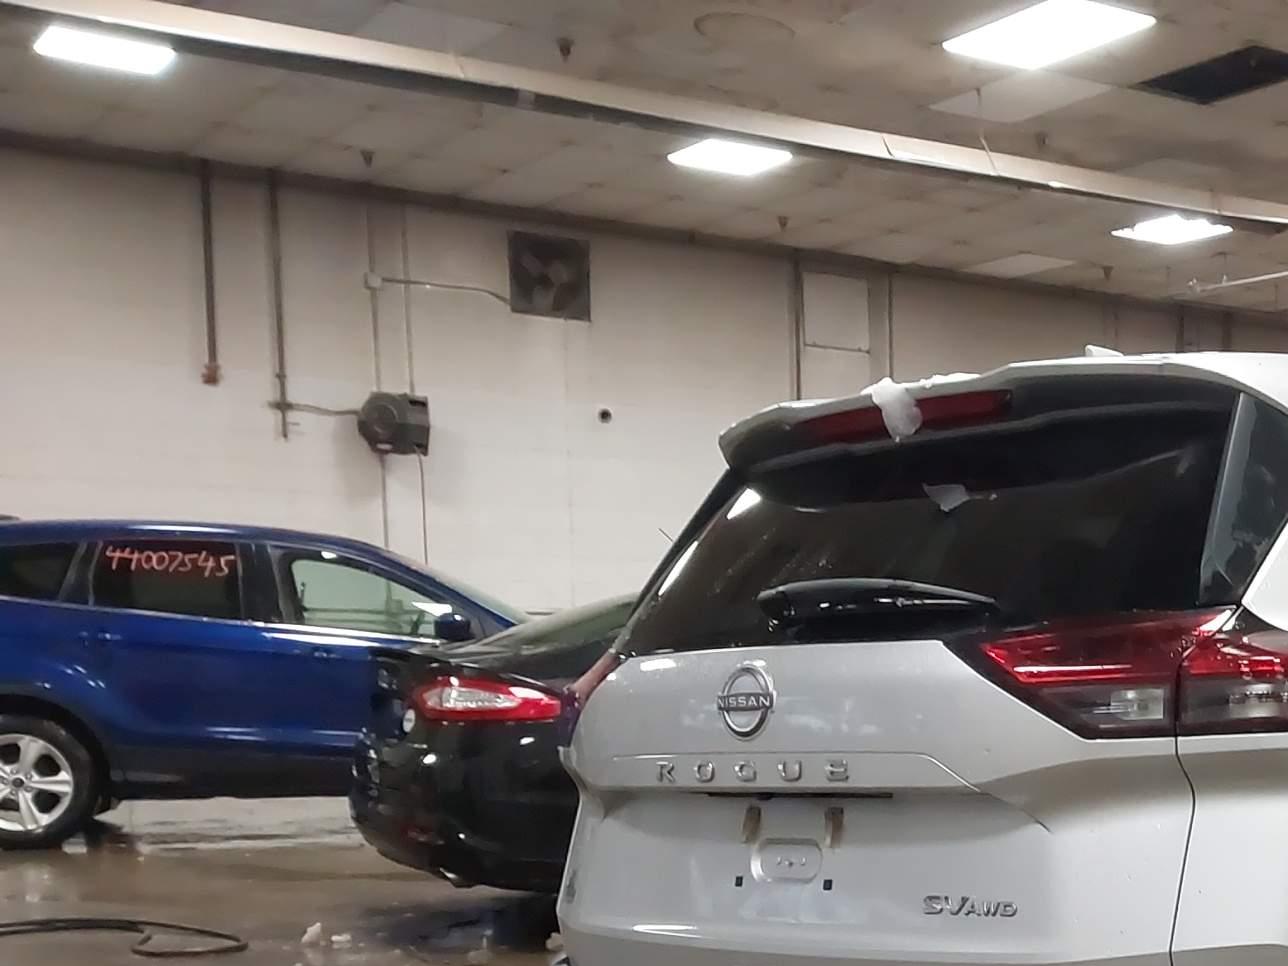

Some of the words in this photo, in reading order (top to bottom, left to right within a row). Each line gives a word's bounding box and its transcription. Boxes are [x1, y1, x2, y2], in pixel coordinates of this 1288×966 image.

[105, 545, 235, 577] 44007545
[718, 694, 771, 708] NISSAN
[655, 760, 849, 783] ROGUE
